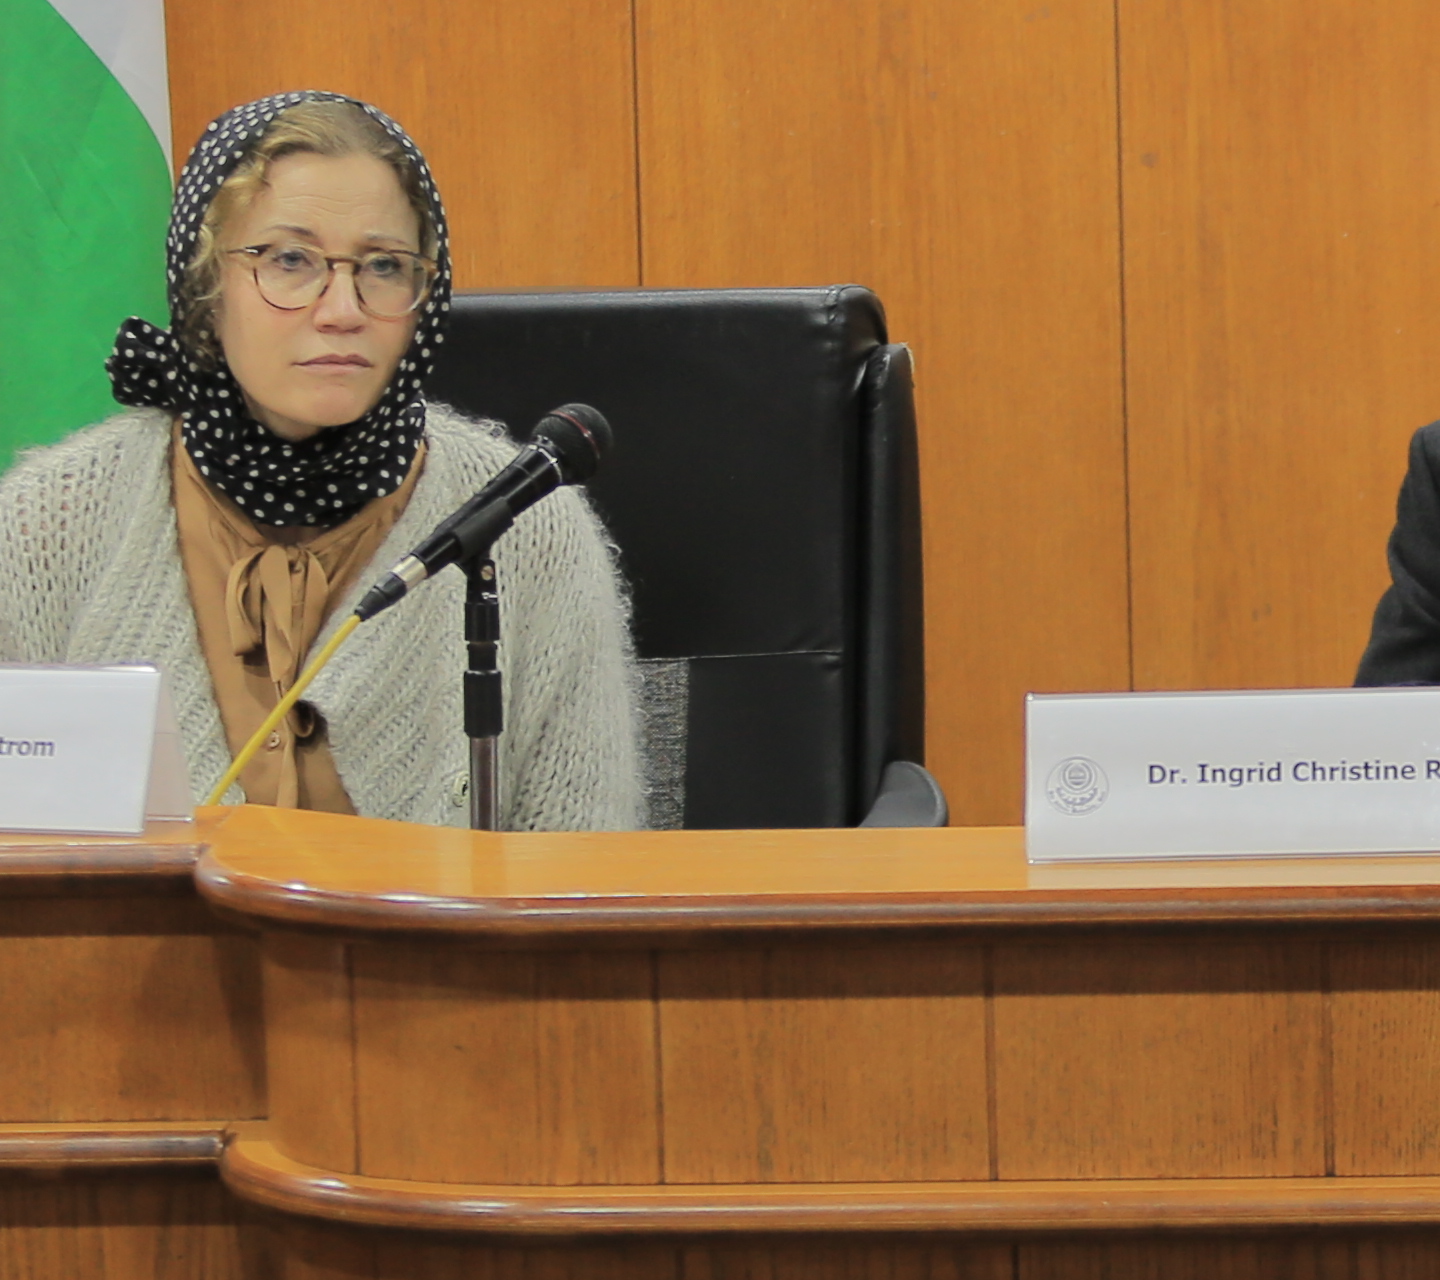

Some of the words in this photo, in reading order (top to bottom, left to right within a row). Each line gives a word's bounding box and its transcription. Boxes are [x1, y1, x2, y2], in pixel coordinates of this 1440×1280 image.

[1148, 764, 1187, 784] Dr.
[1198, 761, 1282, 787] Ingrid
[1292, 759, 1416, 782] Christine
